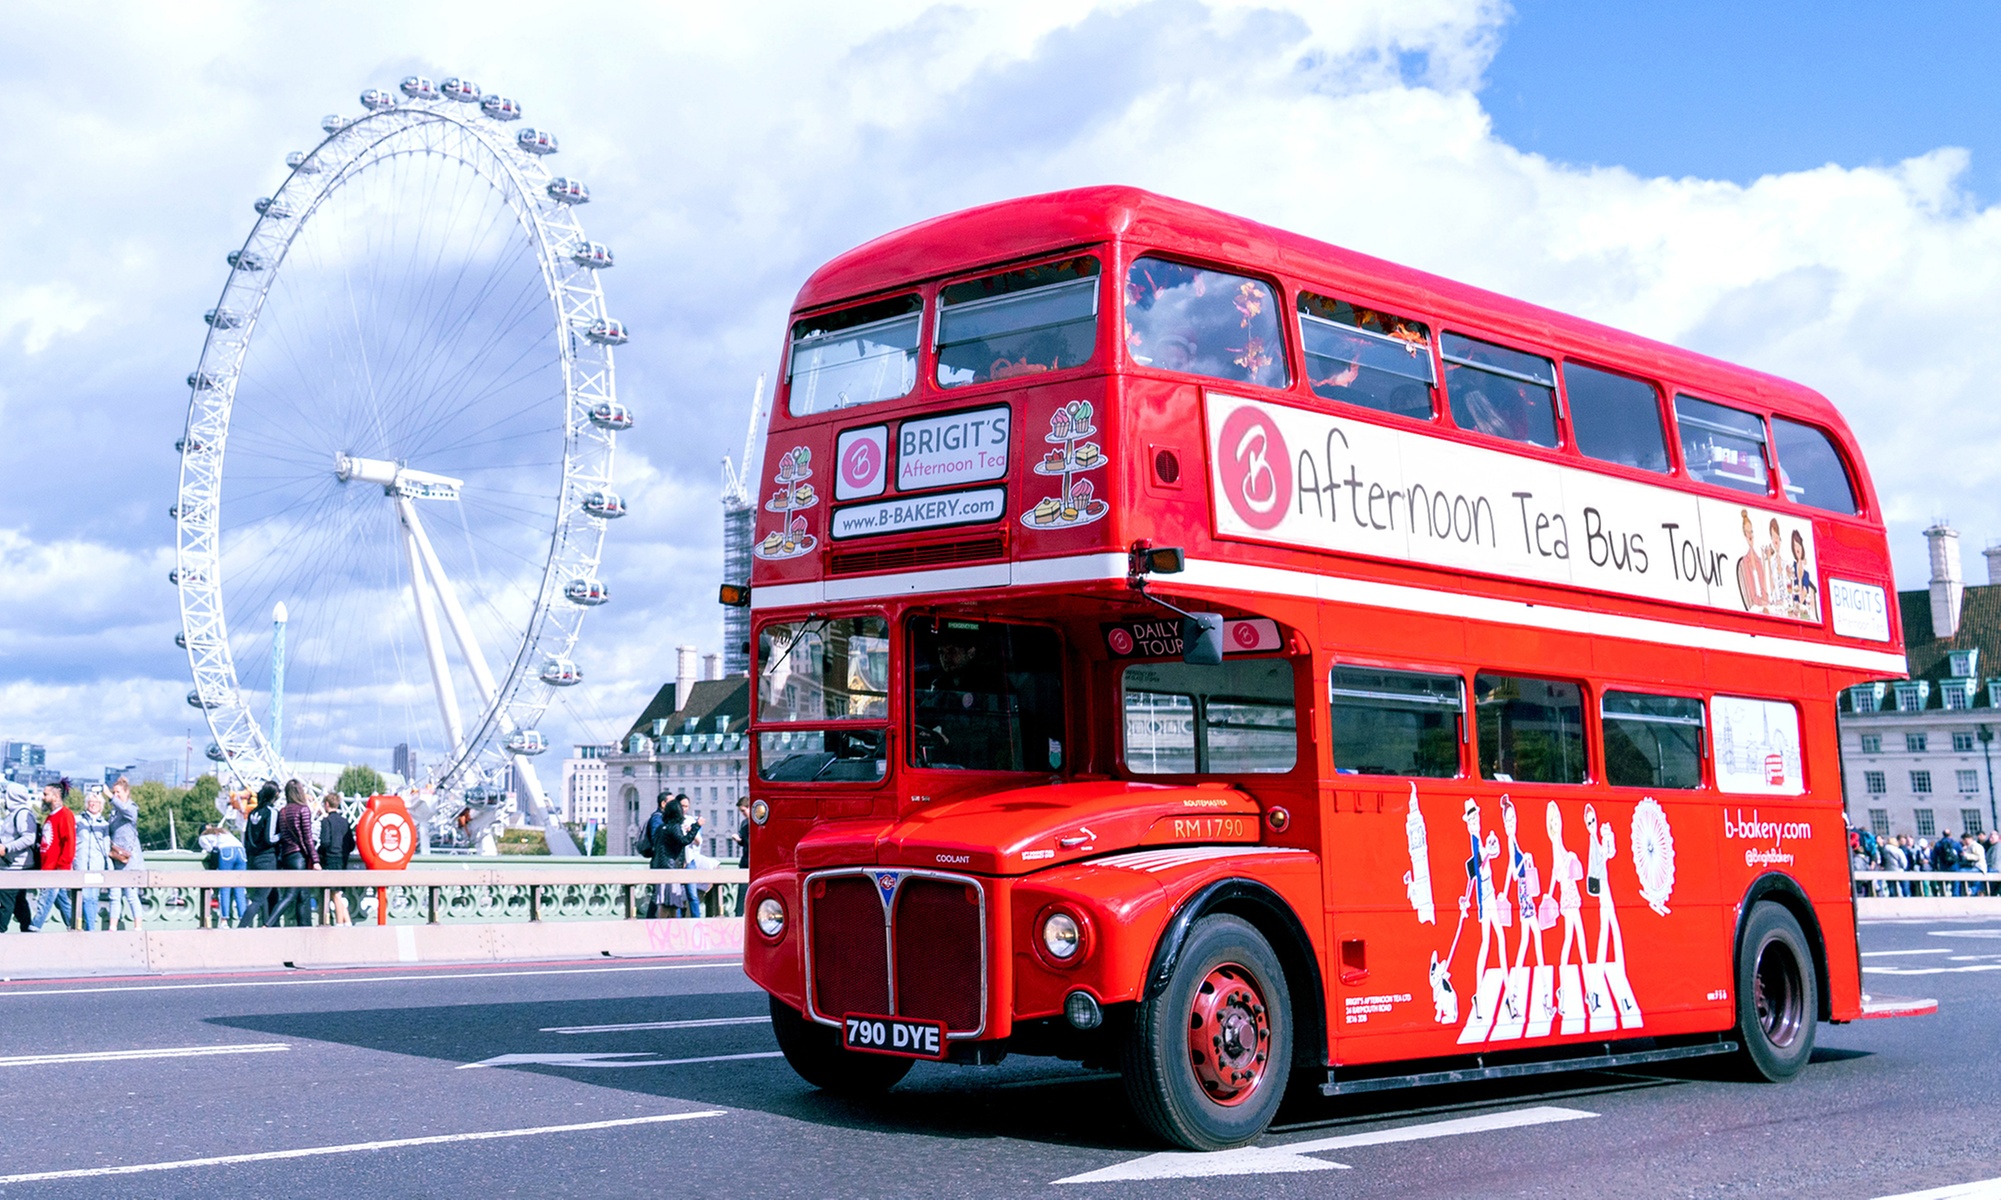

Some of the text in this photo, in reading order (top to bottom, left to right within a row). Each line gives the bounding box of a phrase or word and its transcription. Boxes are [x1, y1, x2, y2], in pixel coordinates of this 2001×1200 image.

[903, 418, 1006, 456] BRIGIT'S
[902, 451, 1006, 478] Afternoon Tea
[843, 499, 994, 531] www.B-BAKERY.com
[1299, 428, 1728, 587] Afternoon Tea Bus Tour
[1833, 585, 1883, 614] BRIGITS
[1133, 621, 1179, 639] DAILY
[1139, 639, 1184, 655] TOUR
[1174, 818, 1243, 838] RM 1790
[1724, 808, 1811, 847] b-bakery.com
[935, 854, 970, 863] COOLANT
[846, 1019, 940, 1053] 790 DYE
